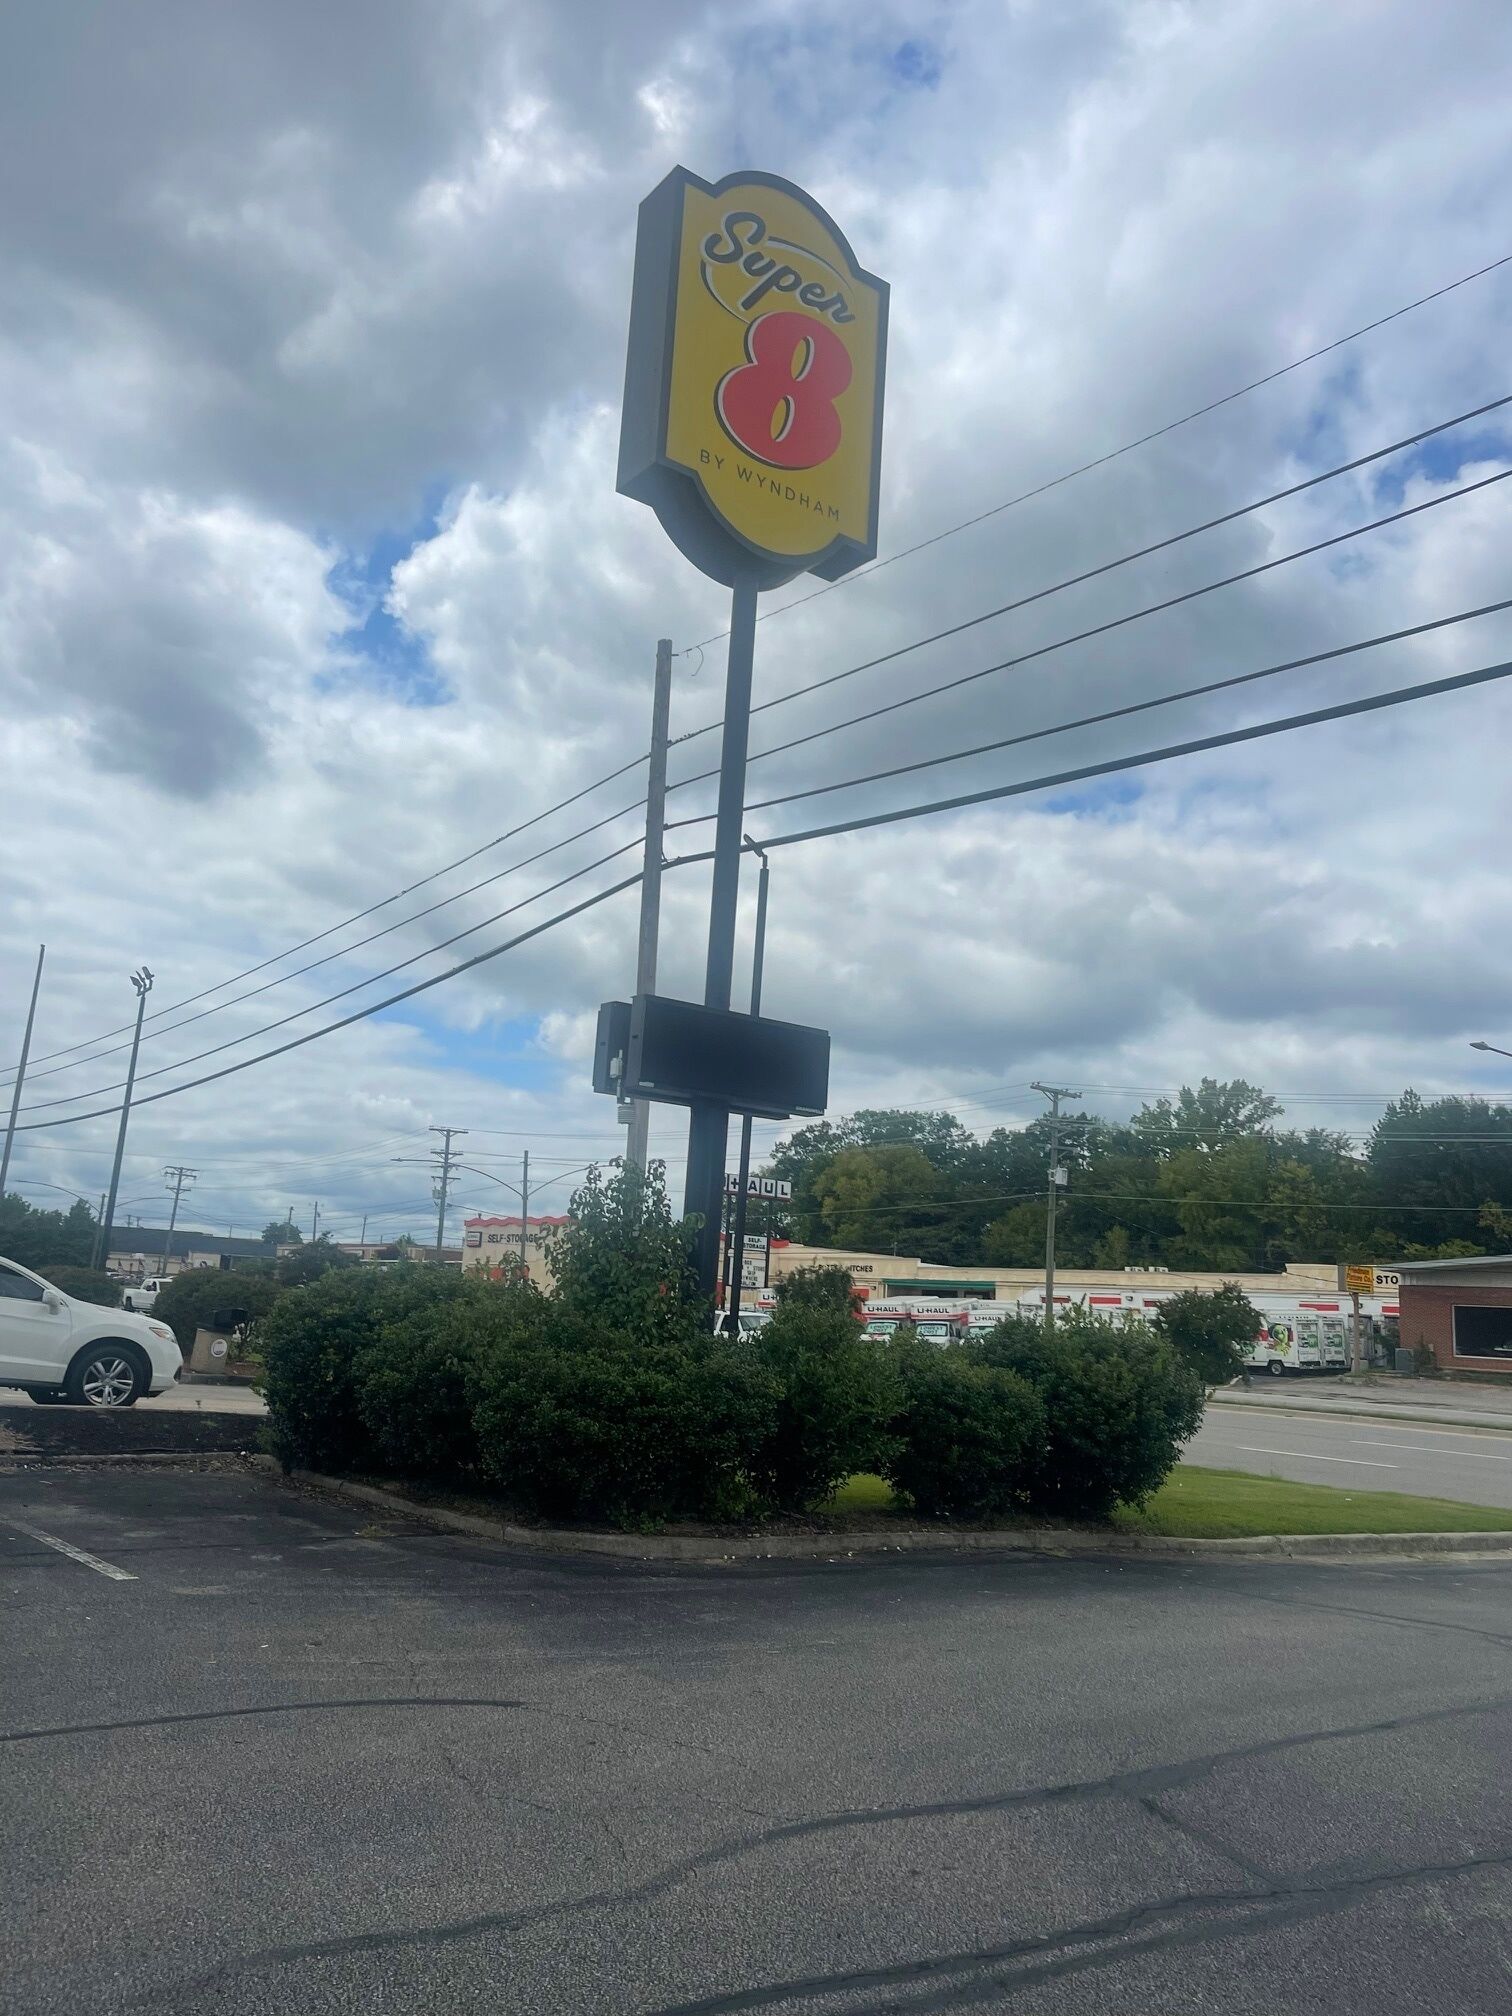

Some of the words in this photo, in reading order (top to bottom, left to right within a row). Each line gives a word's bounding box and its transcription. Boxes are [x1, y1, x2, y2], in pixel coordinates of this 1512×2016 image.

[701, 211, 855, 325] Super
[714, 311, 853, 471] 8
[699, 448, 726, 469] BY
[736, 463, 840, 521] WYNDHAM
[487, 1233, 539, 1243] SELF-STOAGE
